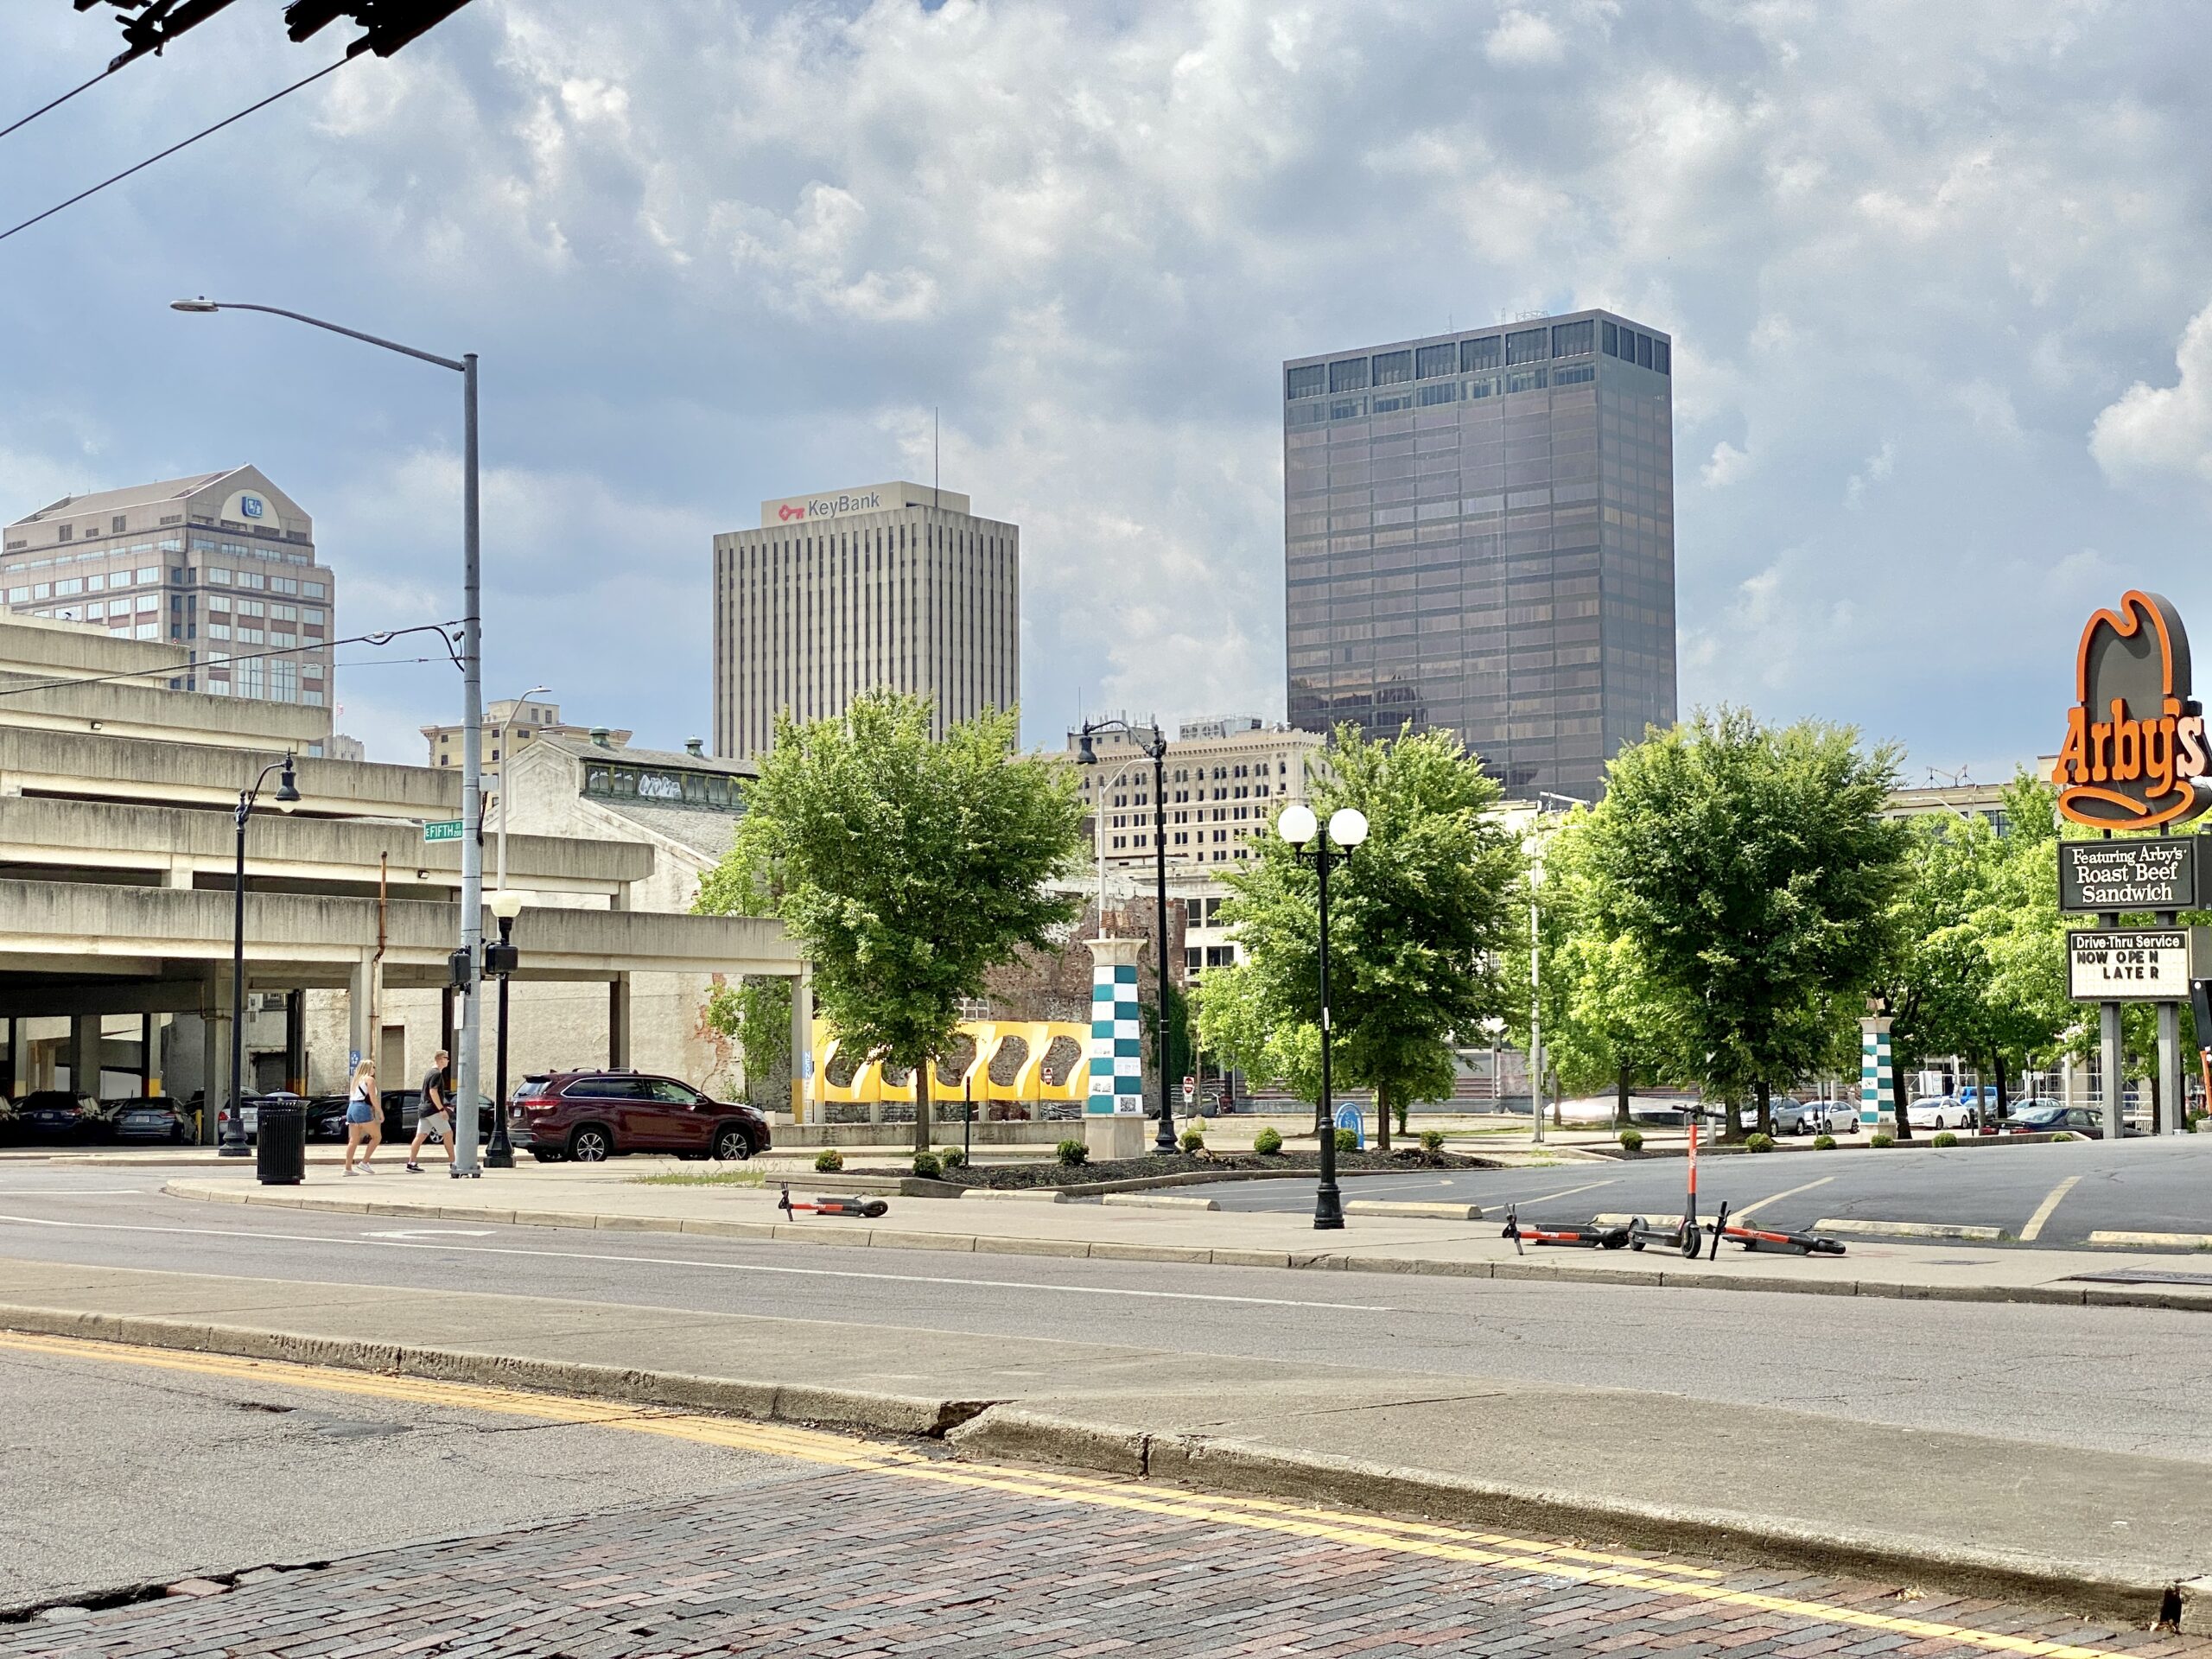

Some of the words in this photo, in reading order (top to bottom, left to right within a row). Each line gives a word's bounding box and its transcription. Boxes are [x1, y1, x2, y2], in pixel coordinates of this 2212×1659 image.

[809, 491, 880, 518] KeyBank
[2052, 697, 2206, 798] Arby's
[429, 824, 454, 838] FIFTH
[2072, 848, 2137, 866] Featuring
[2139, 845, 2183, 865] Arby's
[2076, 865, 2129, 884] Roast
[2135, 861, 2178, 881] Beef
[2082, 882, 2172, 903] Sandwich
[2076, 935, 2133, 949] Drive-Thru
[2136, 934, 2180, 948] Service
[2076, 950, 2108, 963] NOW
[2103, 966, 2159, 979] LATER
